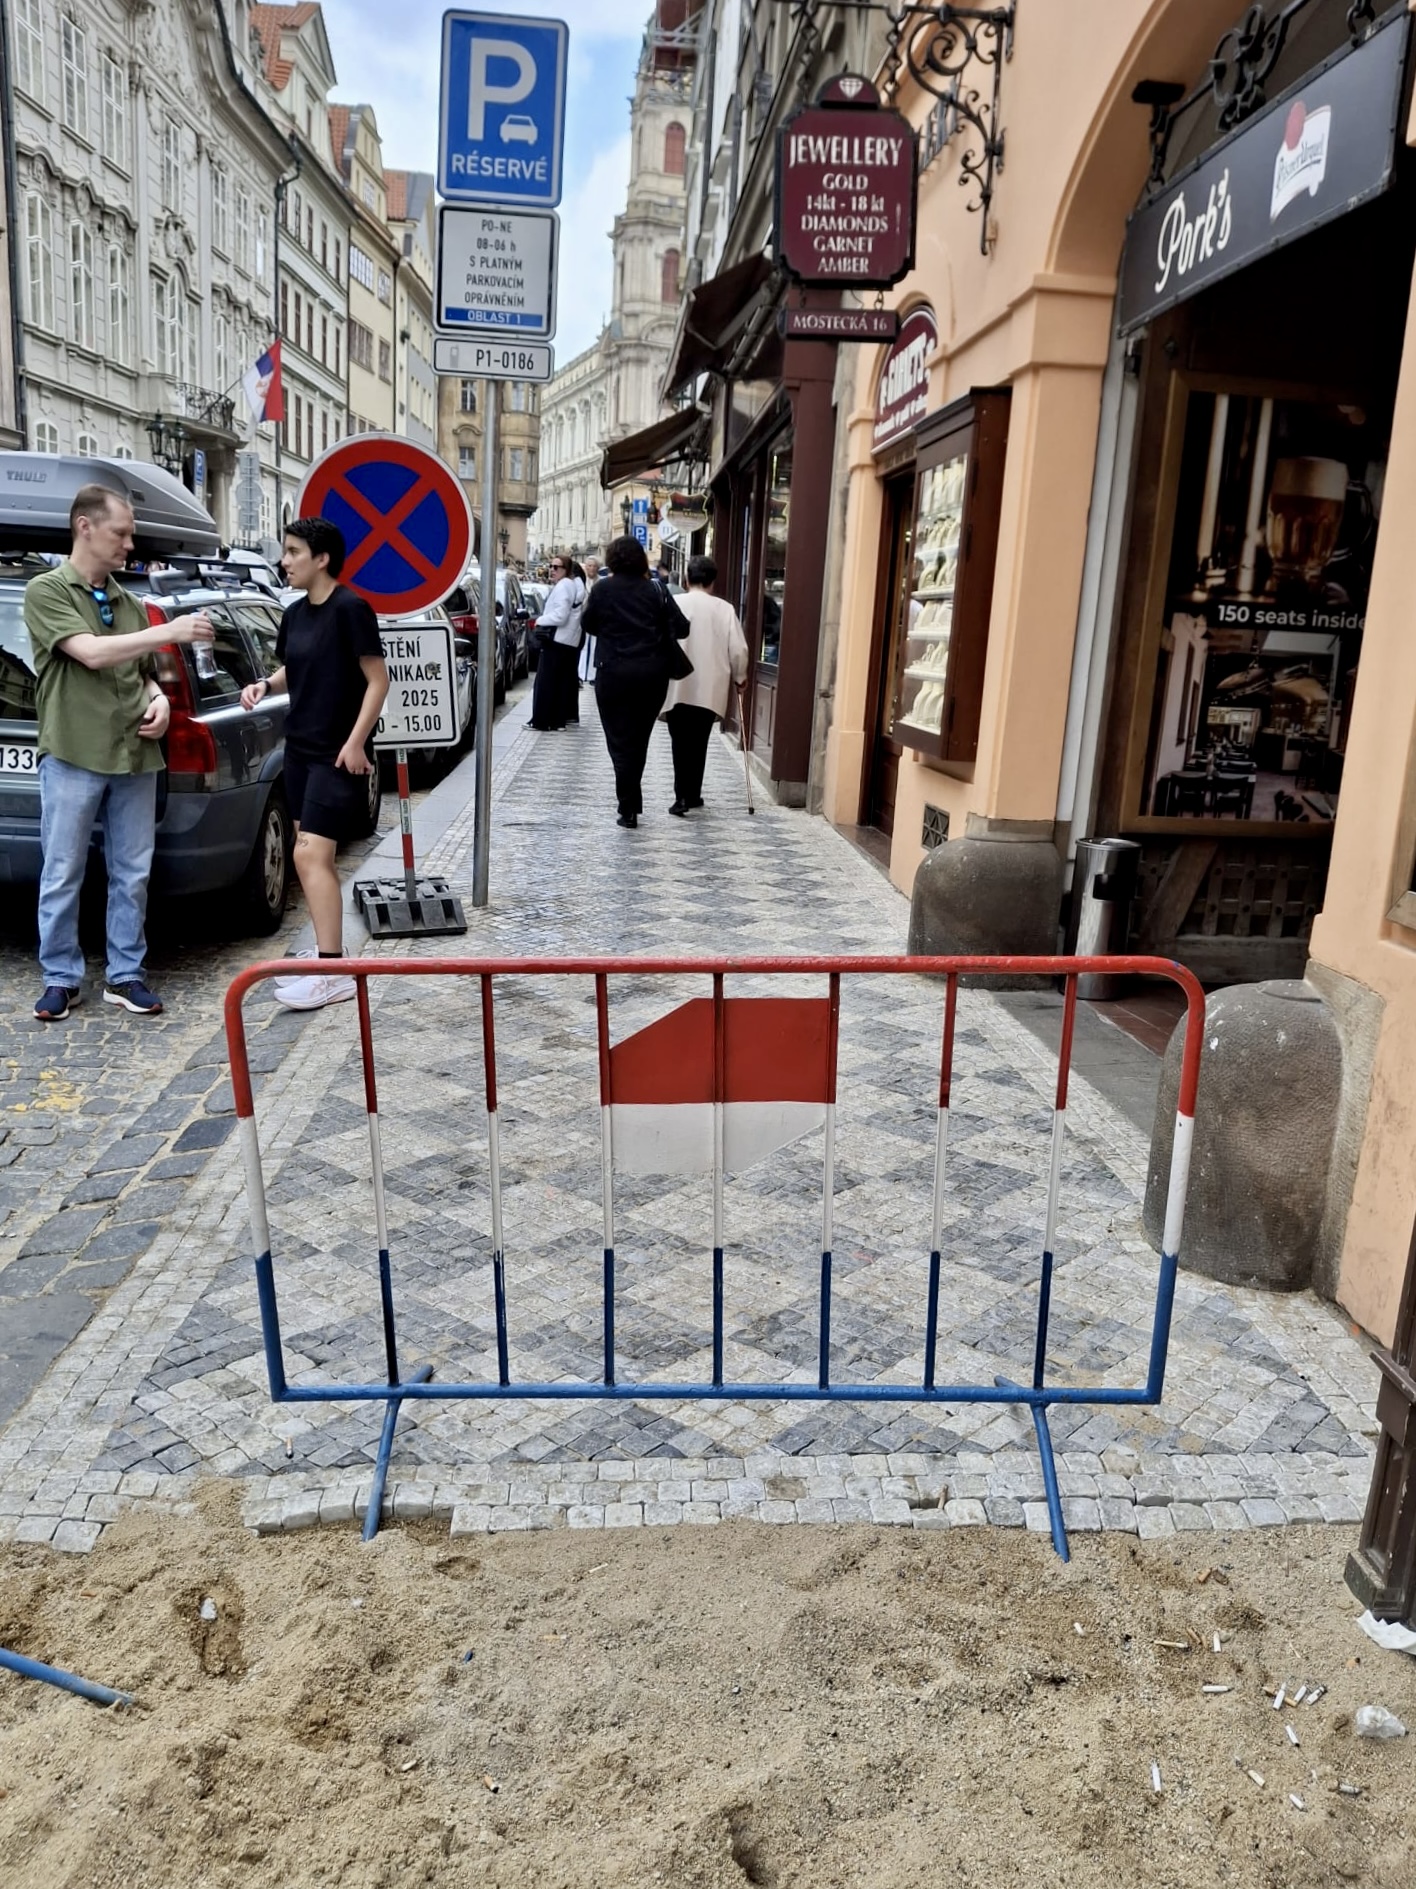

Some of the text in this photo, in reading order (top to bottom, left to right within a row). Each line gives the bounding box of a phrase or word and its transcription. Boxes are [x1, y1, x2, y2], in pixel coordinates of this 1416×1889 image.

[467, 37, 537, 141] P
[789, 134, 902, 168] JEWELLERY
[452, 151, 547, 182] RÉSERVÉ
[822, 172, 868, 190] GOLD
[851, 195, 867, 211] 18
[481, 219, 512, 233] PO-NE
[801, 214, 888, 232] DIAMONDS
[476, 237, 516, 252] 08-06 h
[813, 235, 874, 253] GARNET
[469, 255, 522, 271] S PLATNÝM
[817, 256, 869, 273] AMBER
[466, 273, 524, 289] PARKOVACÍM
[464, 290, 524, 307] OPRÁVNĚNÍM
[467, 309, 520, 324] OBLAST 1
[793, 312, 887, 331] MOSTECKÁ 16
[476, 348, 534, 370] P1-0186
[1218, 605, 1250, 622] 150
[1255, 610, 1306, 626] seats
[381, 635, 421, 659] ŠTĚNÍ
[388, 662, 442, 682] NIKACE
[401, 690, 438, 707] 2025
[0, 747, 39, 770] 133
